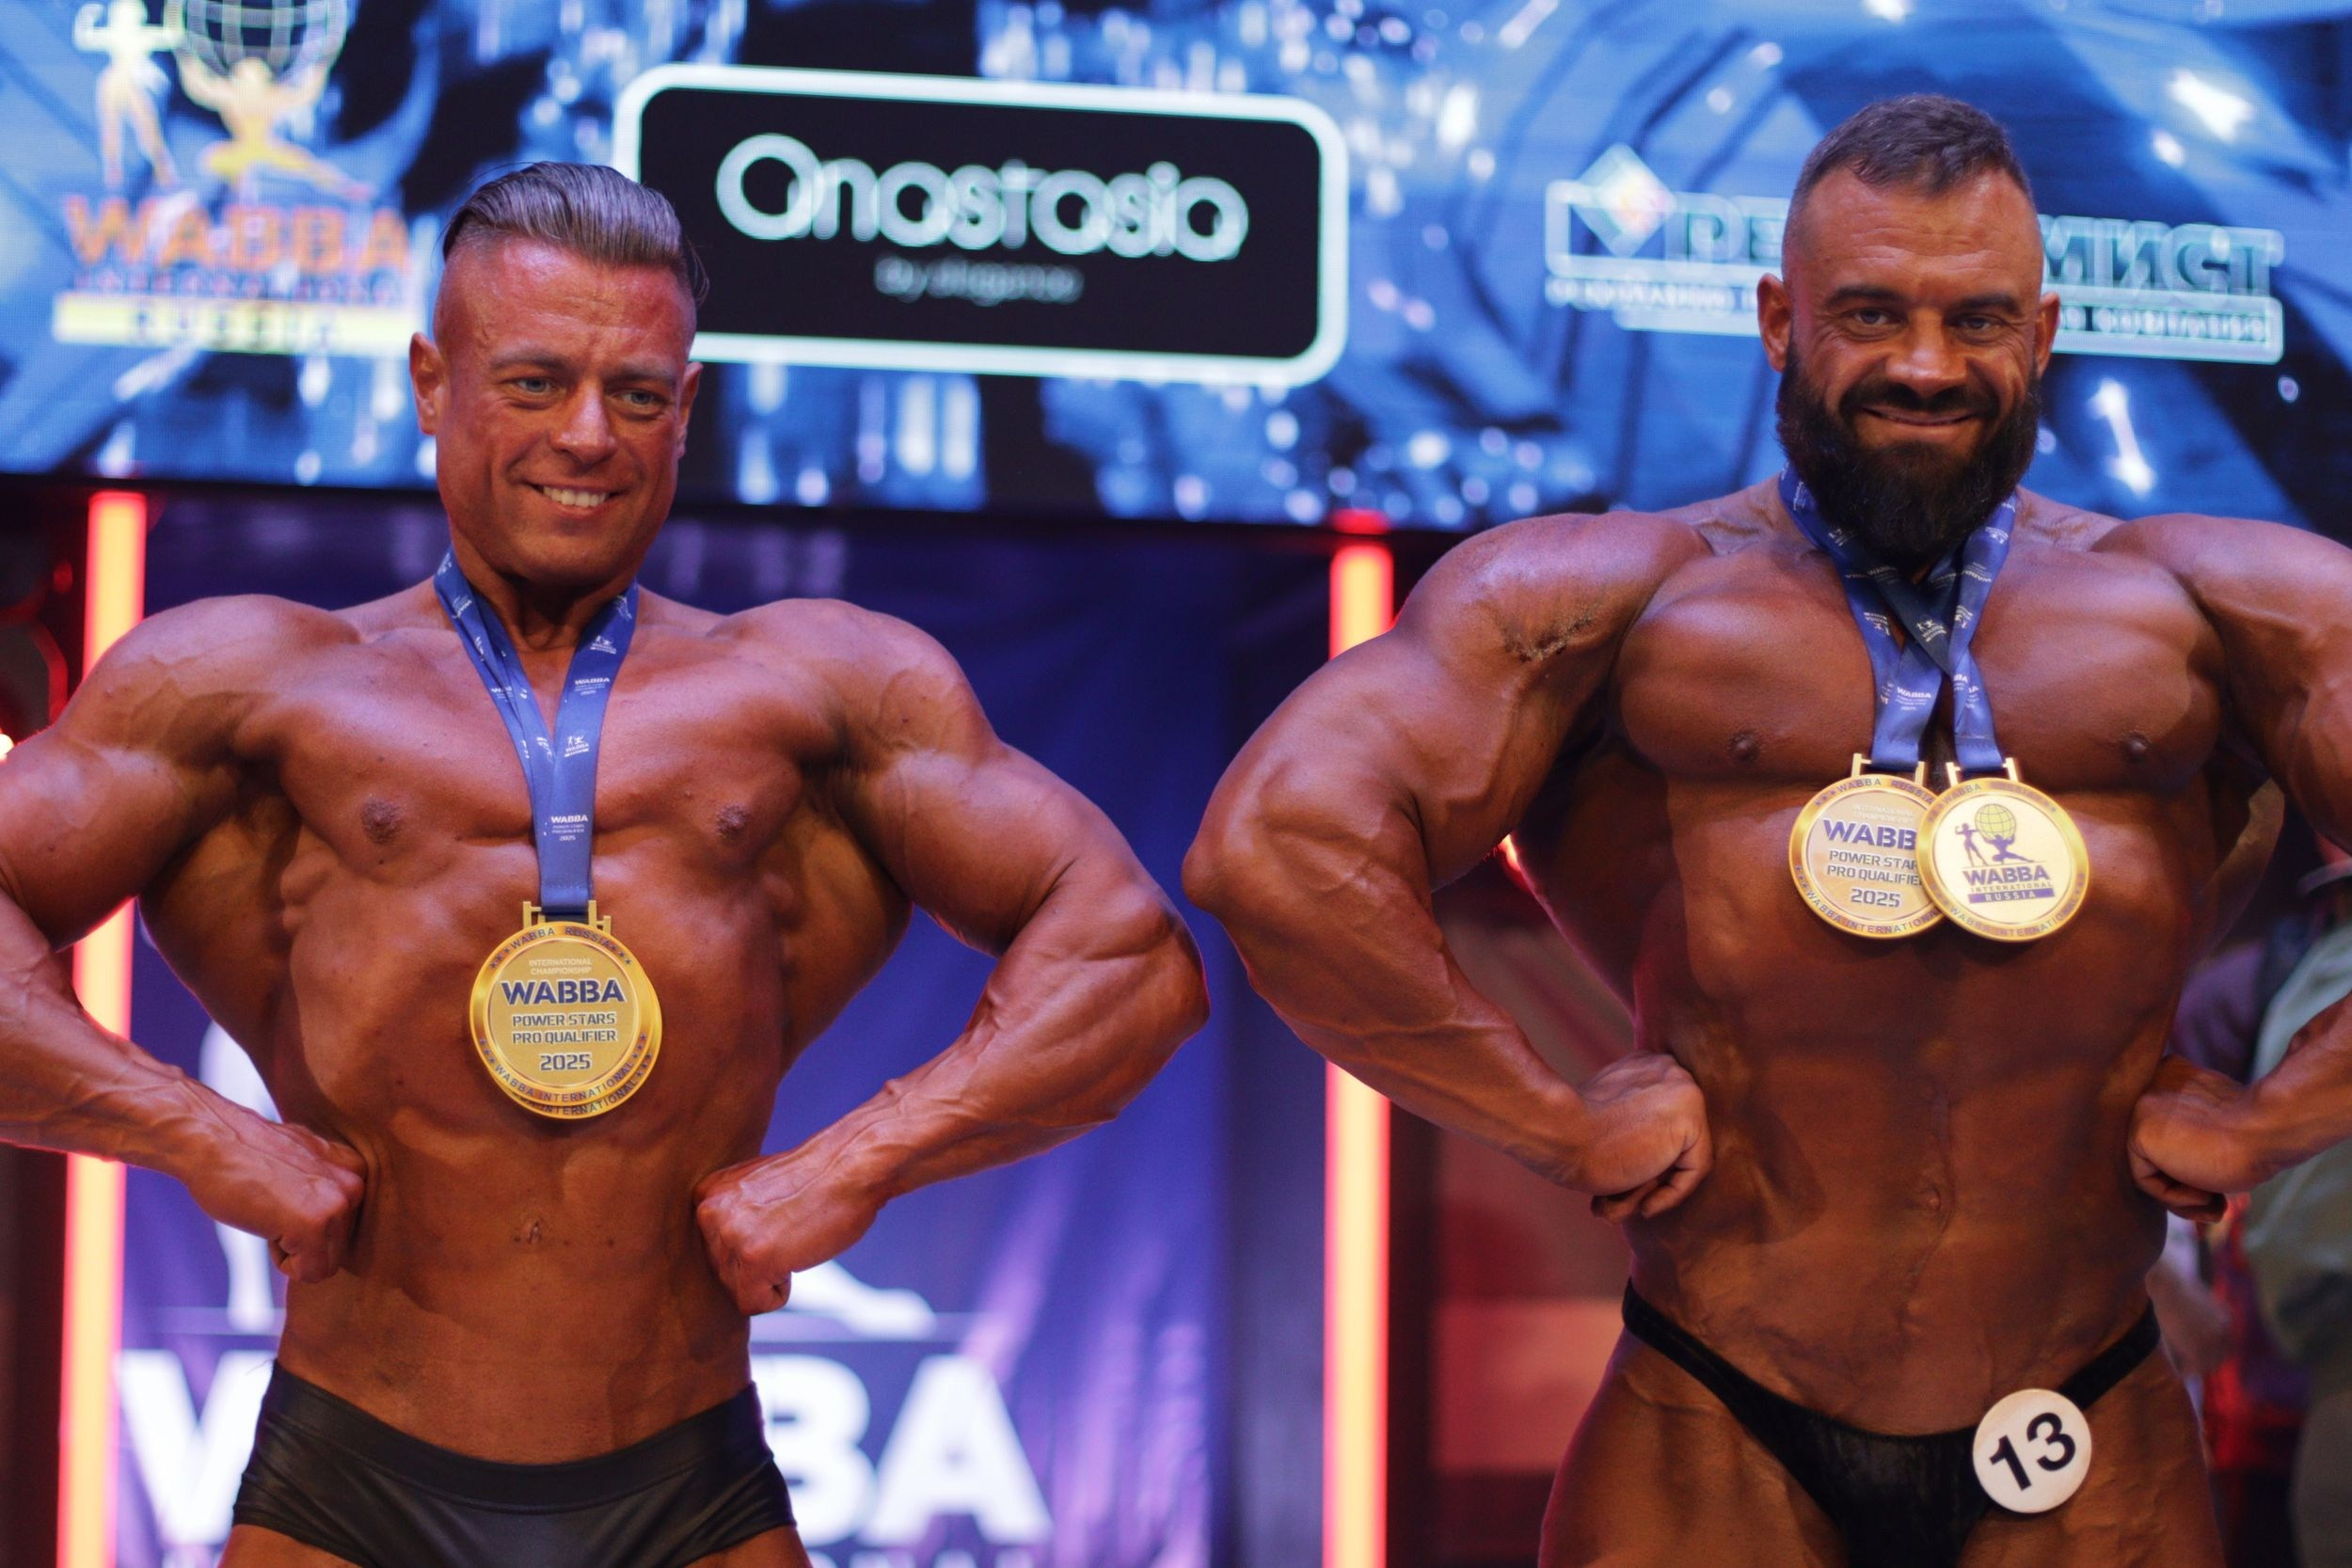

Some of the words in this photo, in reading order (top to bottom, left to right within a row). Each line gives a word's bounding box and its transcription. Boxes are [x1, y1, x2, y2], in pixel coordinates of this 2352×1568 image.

[64, 194, 411, 273] WABBA
[1897, 687, 1931, 699] WABBA
[1836, 778, 1883, 793] WABBA
[551, 815, 589, 824] WABBA
[1823, 819, 1916, 851] WABB
[1829, 849, 1881, 866] POWER
[1827, 864, 1856, 879] PRO
[1963, 865, 2051, 886] WABBA
[1971, 881, 2054, 893] INTERNATIONAL
[1851, 888, 1901, 908] 2025
[1985, 891, 2037, 902] RUSSIA
[1806, 891, 1842, 923] WABBA
[511, 927, 556, 949] WABBA
[564, 926, 612, 947] RUSSIA
[528, 958, 593, 967] INTERNATIONAL
[531, 966, 593, 975] CHAMPIONSHIP
[501, 978, 627, 1006] WABBA
[512, 1013, 565, 1027] POWER
[568, 1012, 616, 1025] STARS
[513, 1032, 542, 1045] PRO
[545, 1029, 617, 1045] QUALIFIER
[540, 1053, 592, 1071] 2025
[495, 1063, 534, 1097] WABBA
[539, 1062, 635, 1102] INTERNATIONAL
[1989, 1412, 2076, 1492] 13
